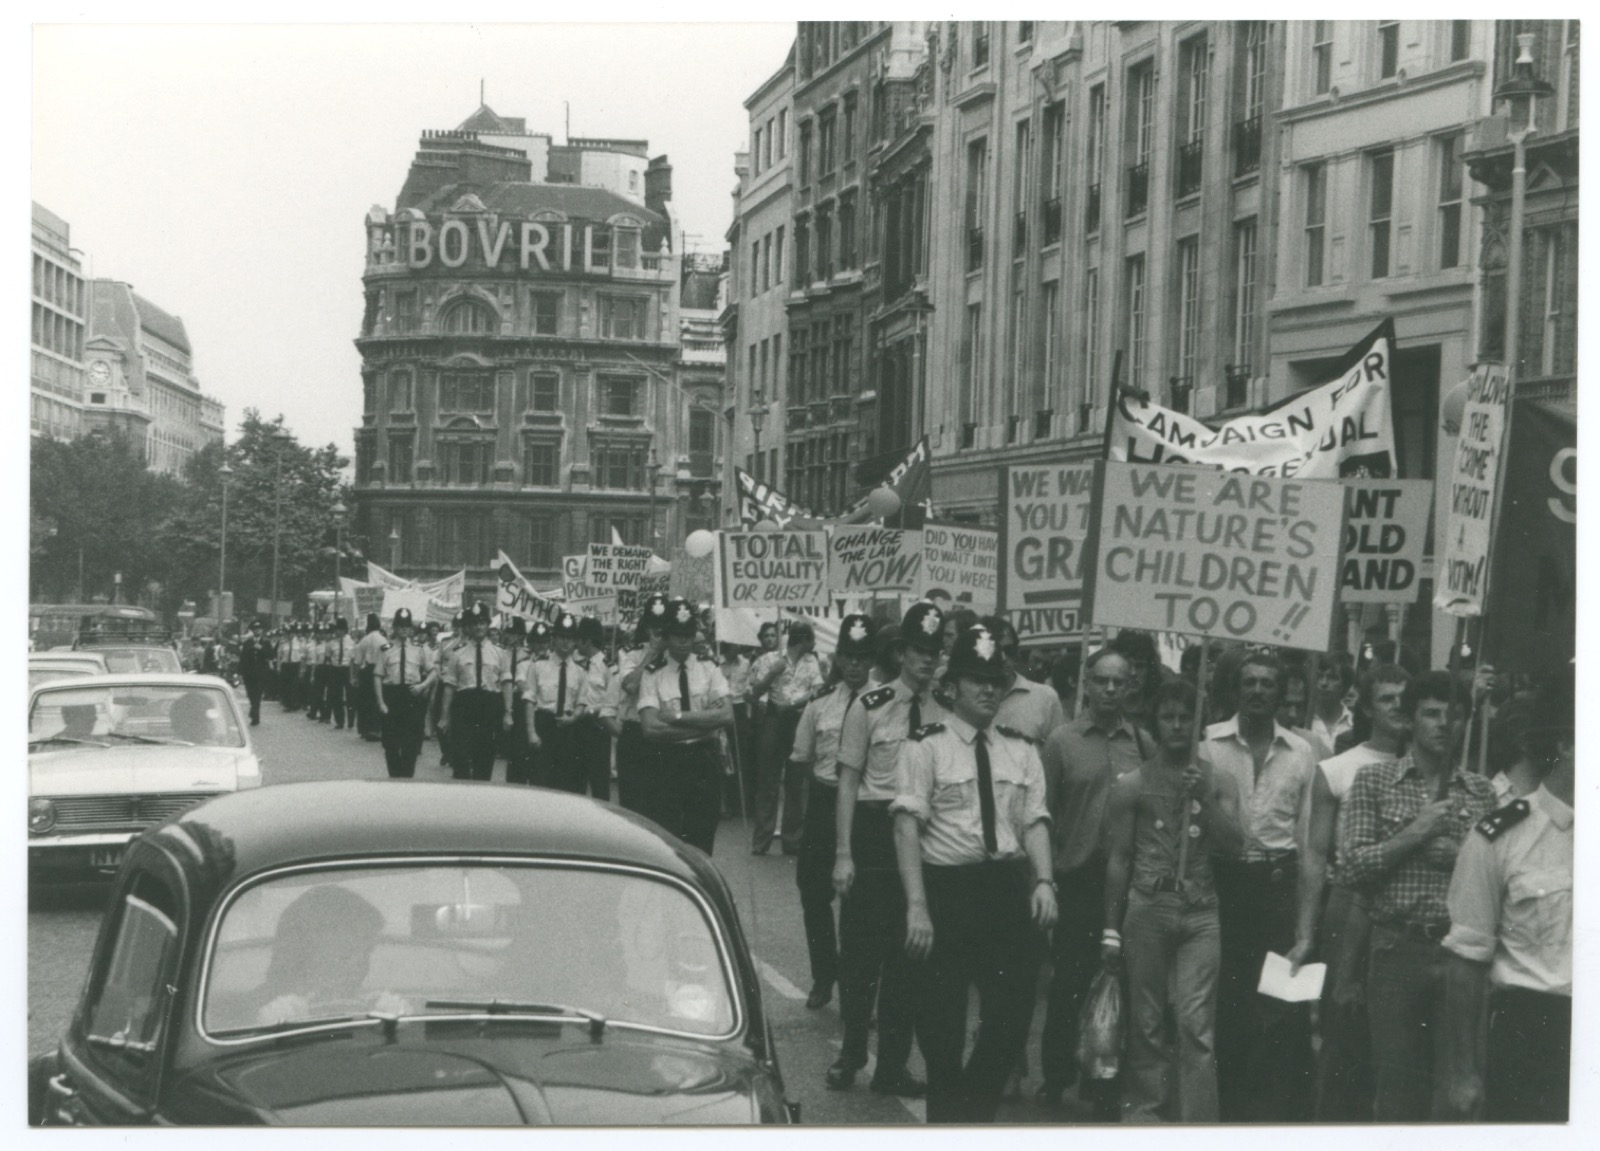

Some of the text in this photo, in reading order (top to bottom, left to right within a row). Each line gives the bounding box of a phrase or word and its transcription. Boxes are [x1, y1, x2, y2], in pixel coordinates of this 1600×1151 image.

[409, 220, 609, 274] BOVRIL
[1330, 352, 1386, 411] FOR
[1012, 470, 1049, 498] WE
[1132, 469, 1303, 517] WE ARE
[1349, 488, 1402, 518] NT
[1014, 504, 1069, 531] YOU
[834, 530, 905, 551] CHANGE
[925, 528, 948, 546] DID
[951, 532, 978, 551] YOU
[1113, 504, 1317, 560] NATURE'S
[590, 545, 652, 559] WE DEMAND
[731, 535, 825, 561] TOTAL
[838, 544, 902, 564] THE LAW
[924, 547, 939, 561] TO
[941, 550, 971, 565] WAIT
[592, 558, 647, 571] THE RIGHT
[592, 571, 608, 584] TO
[733, 561, 825, 580] EQUALITY
[845, 552, 921, 588] NOW!
[926, 563, 996, 591] YOU WERE
[1105, 546, 1318, 601] CHILDREN
[733, 581, 824, 602] OR BUST!
[1154, 592, 1257, 636] TOO
